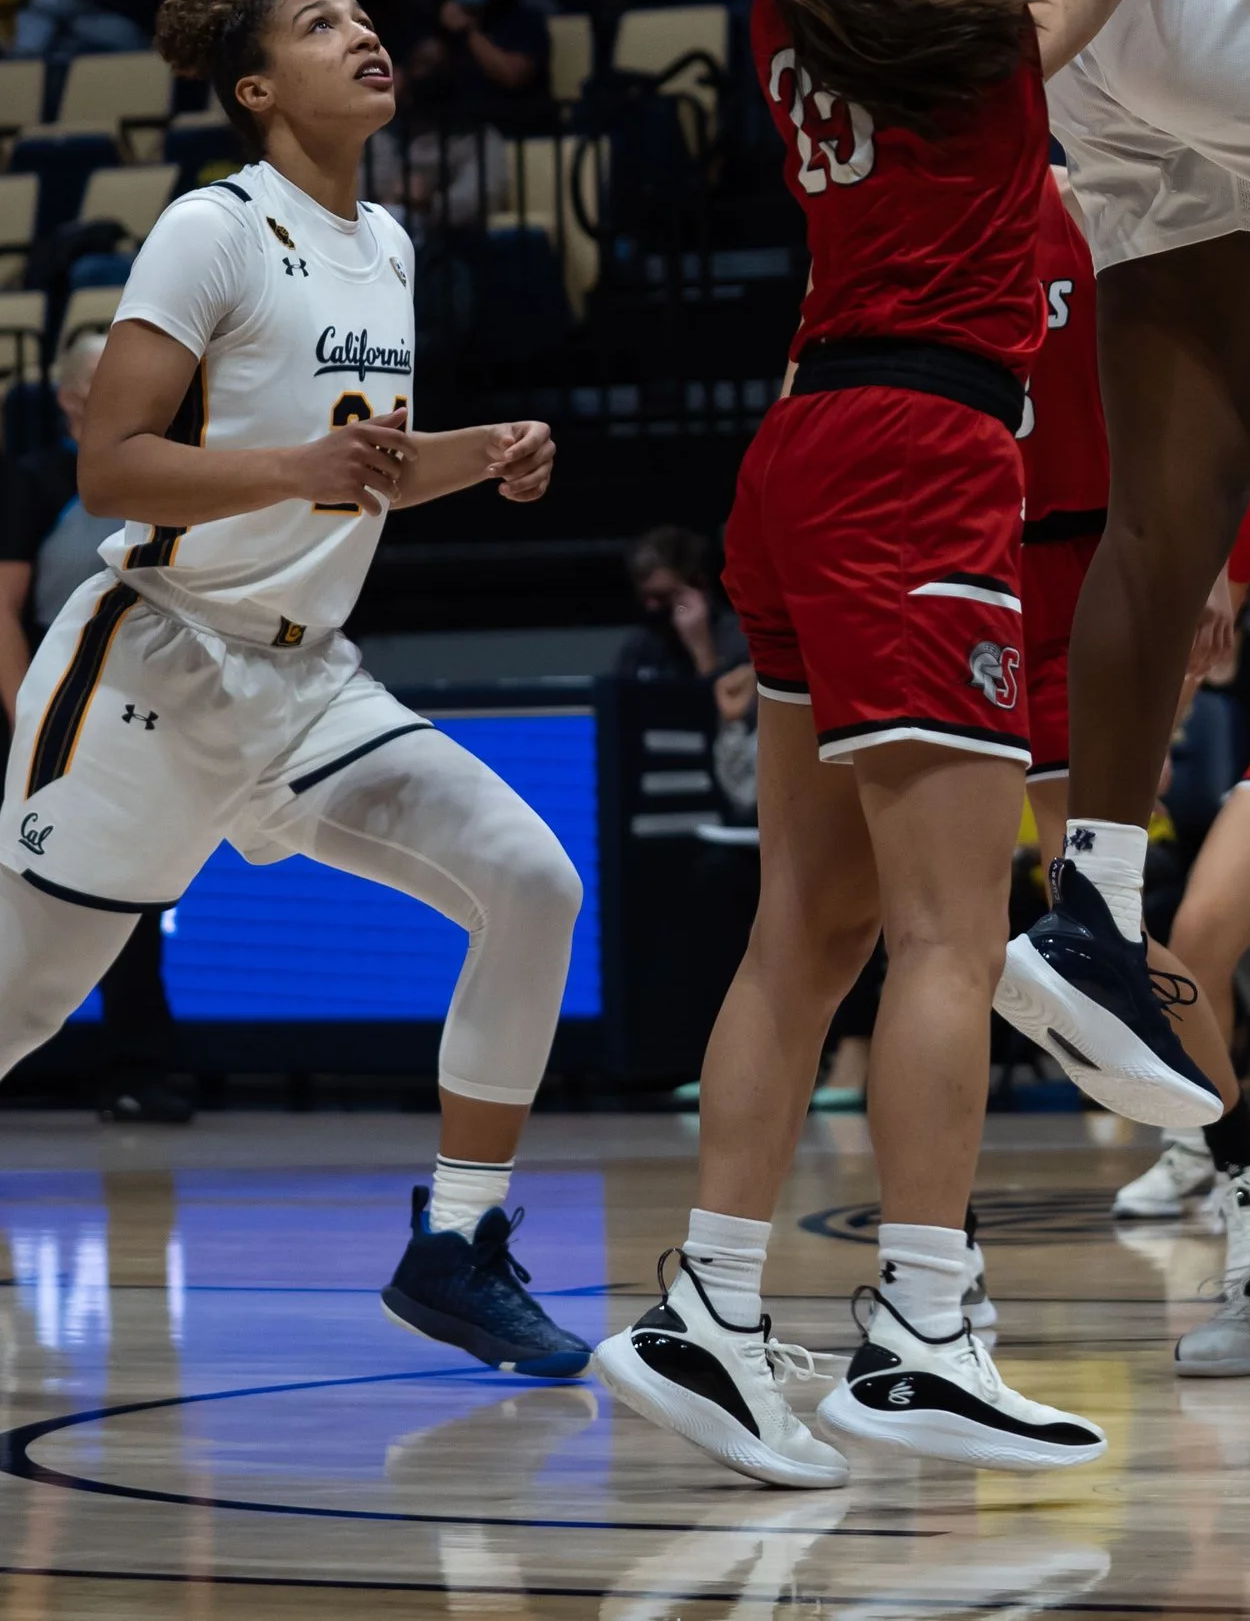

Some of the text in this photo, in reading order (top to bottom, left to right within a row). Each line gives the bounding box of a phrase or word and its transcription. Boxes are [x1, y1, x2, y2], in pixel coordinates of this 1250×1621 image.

[1038, 279, 1074, 329] S
[314, 326, 412, 382] California
[17, 812, 54, 855] Cal
